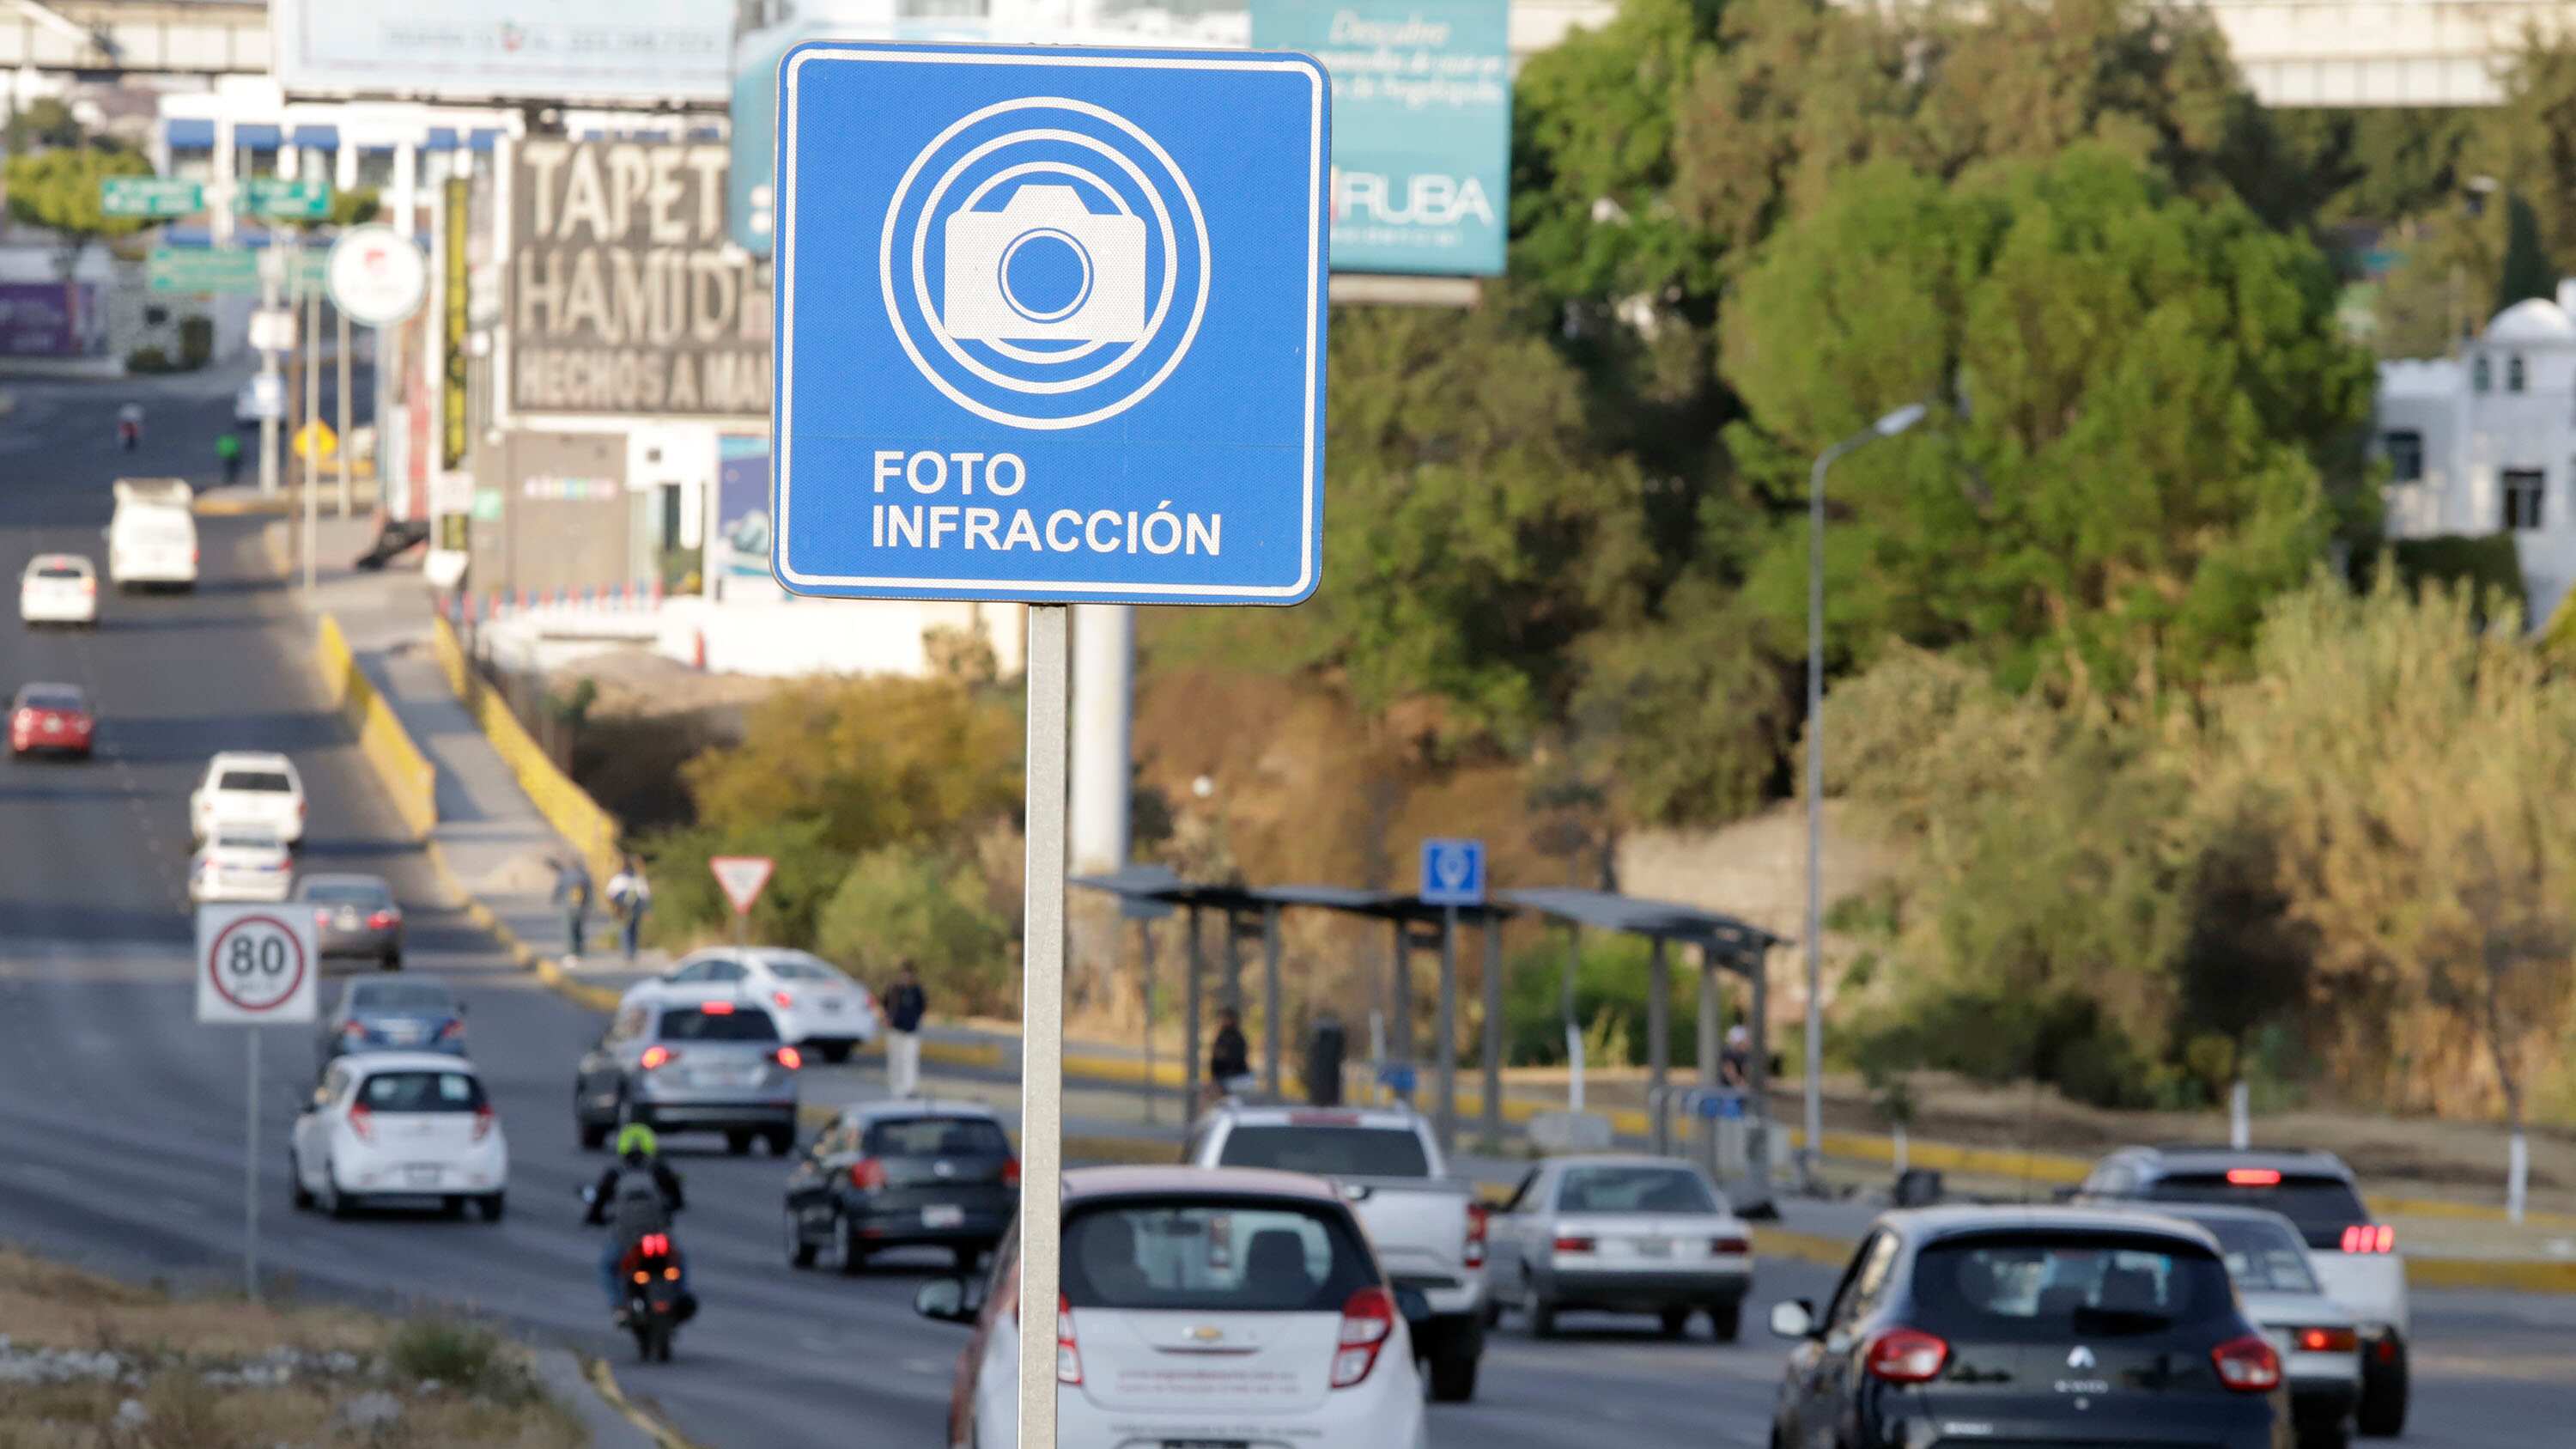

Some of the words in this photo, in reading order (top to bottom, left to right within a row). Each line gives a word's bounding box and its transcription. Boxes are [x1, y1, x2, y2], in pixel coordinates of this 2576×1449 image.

[873, 450, 1027, 496] FOTO
[872, 500, 1222, 556] INFRACCIÓN
[231, 935, 285, 977] 80
